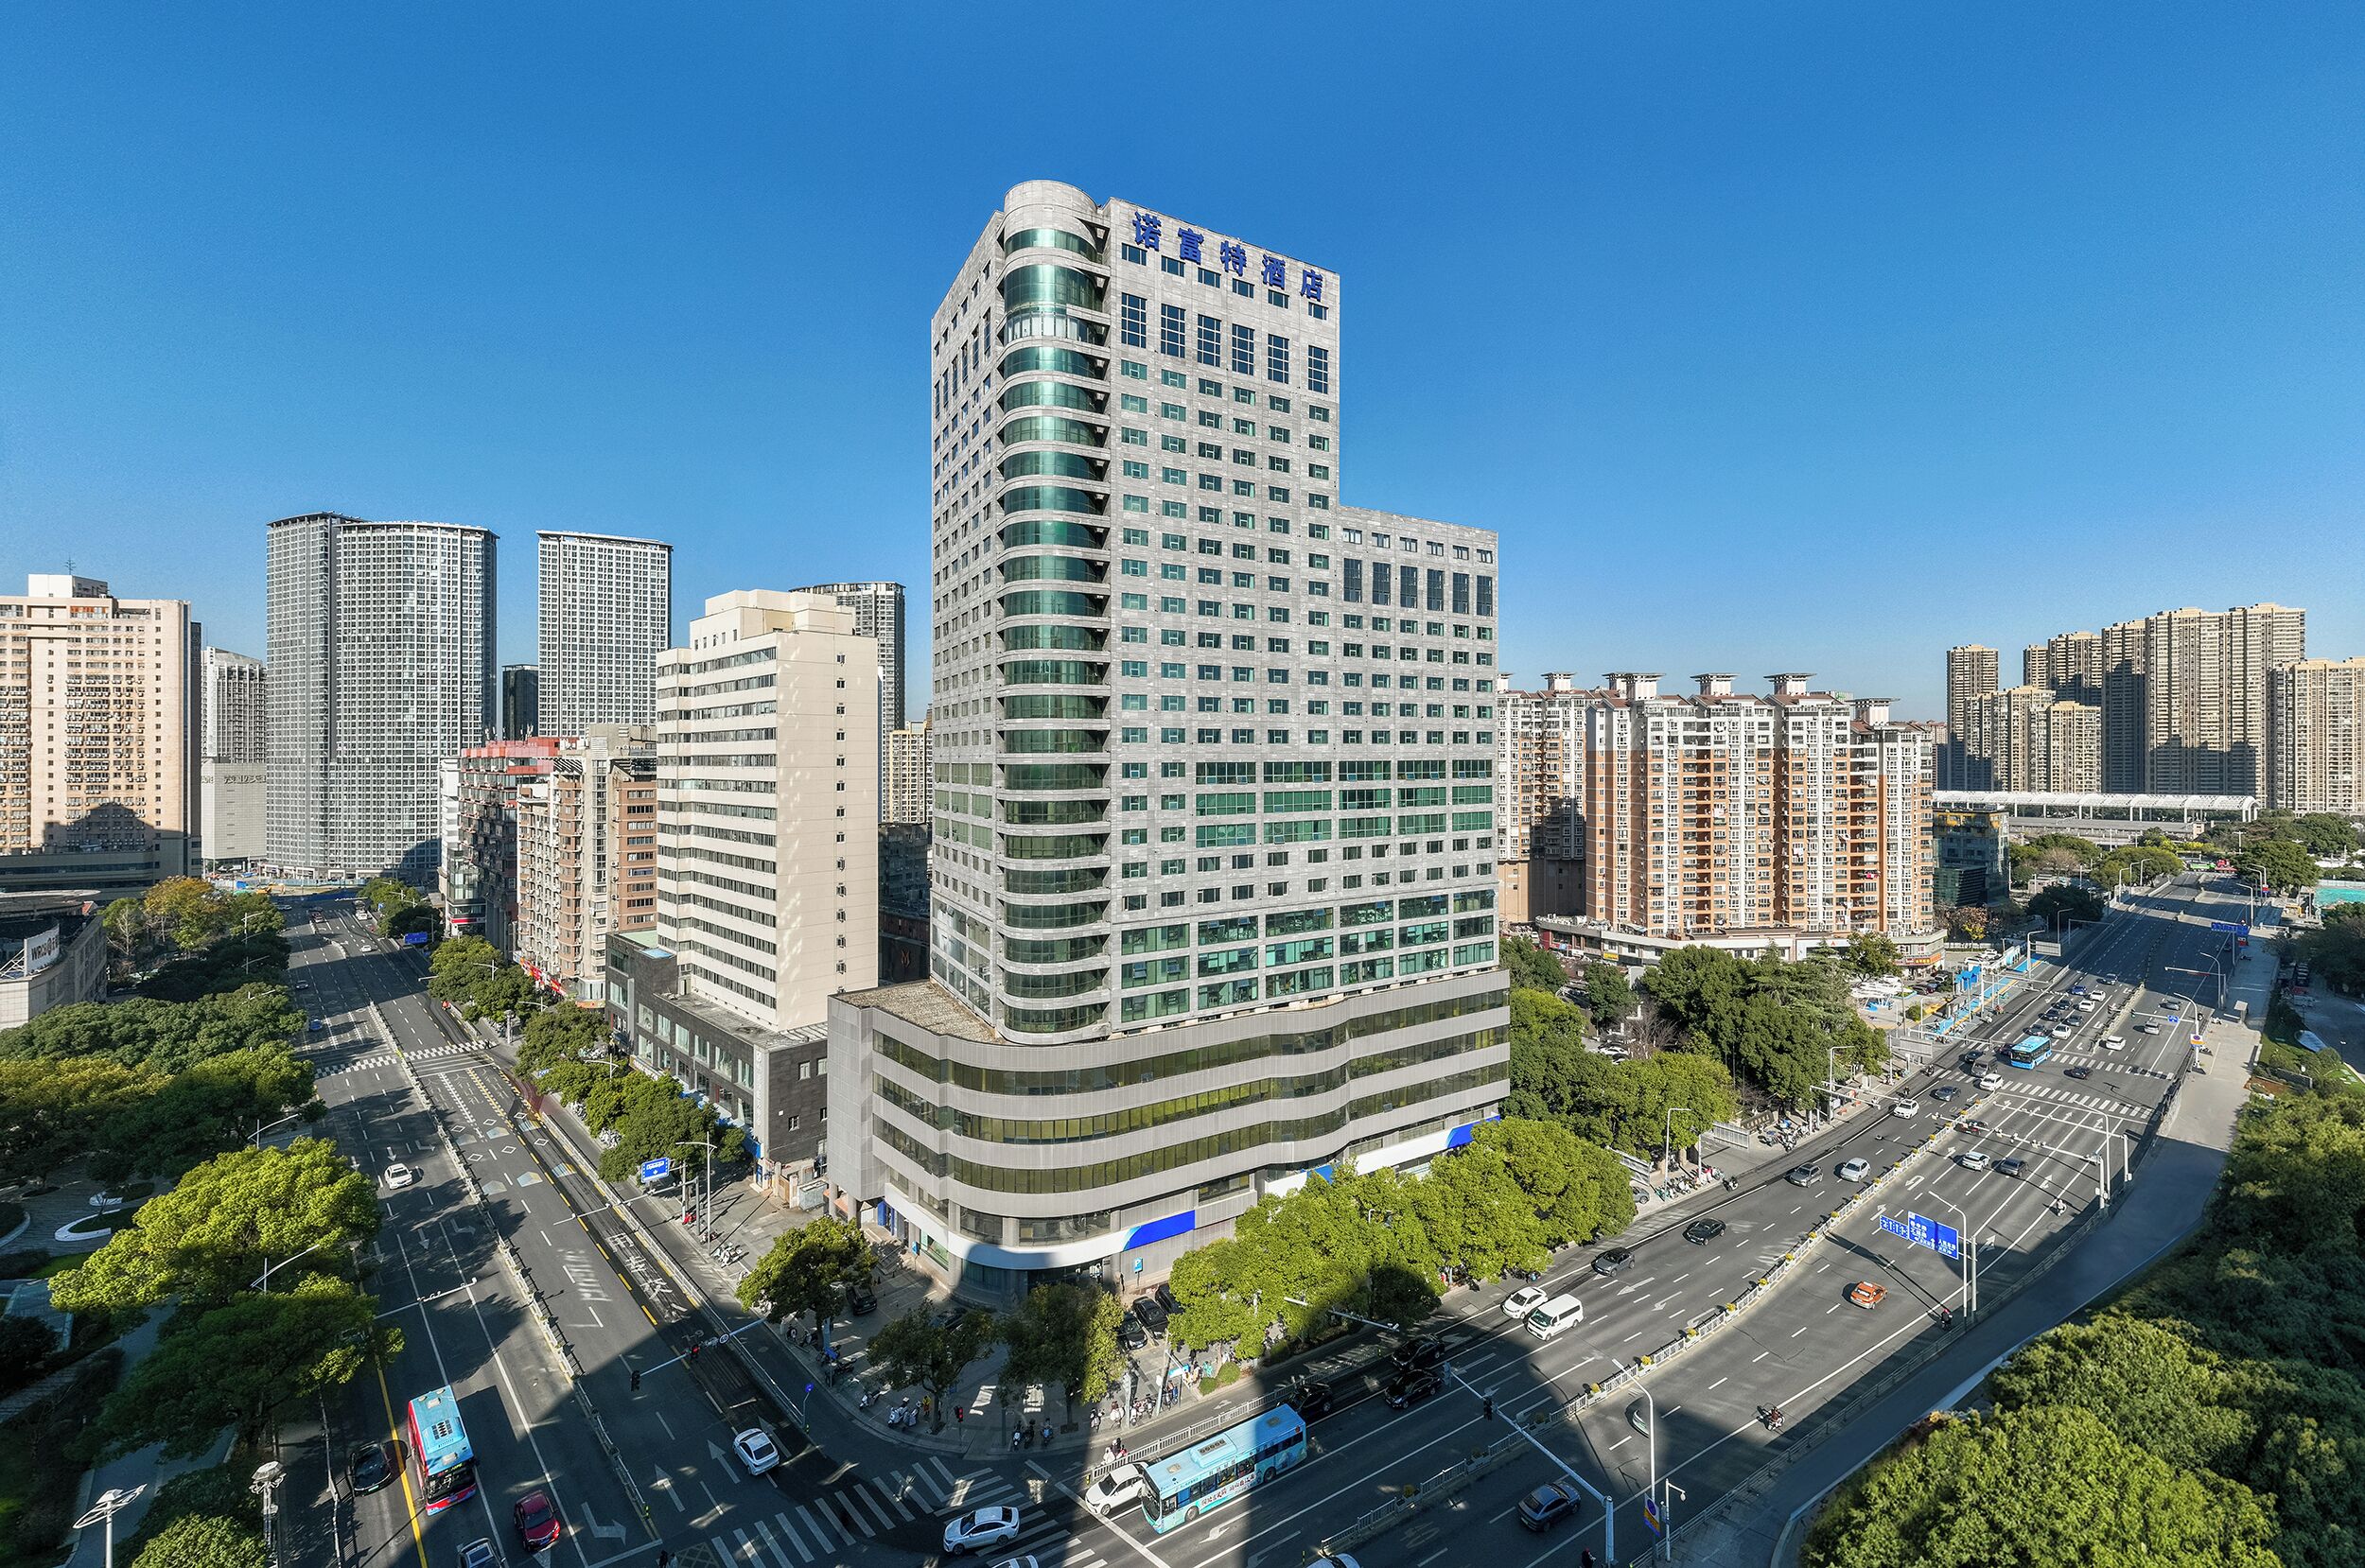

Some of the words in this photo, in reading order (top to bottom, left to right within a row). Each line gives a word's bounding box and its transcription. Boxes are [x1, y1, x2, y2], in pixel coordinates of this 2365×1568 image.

[1132, 211, 1323, 302] 诺富特酒店
